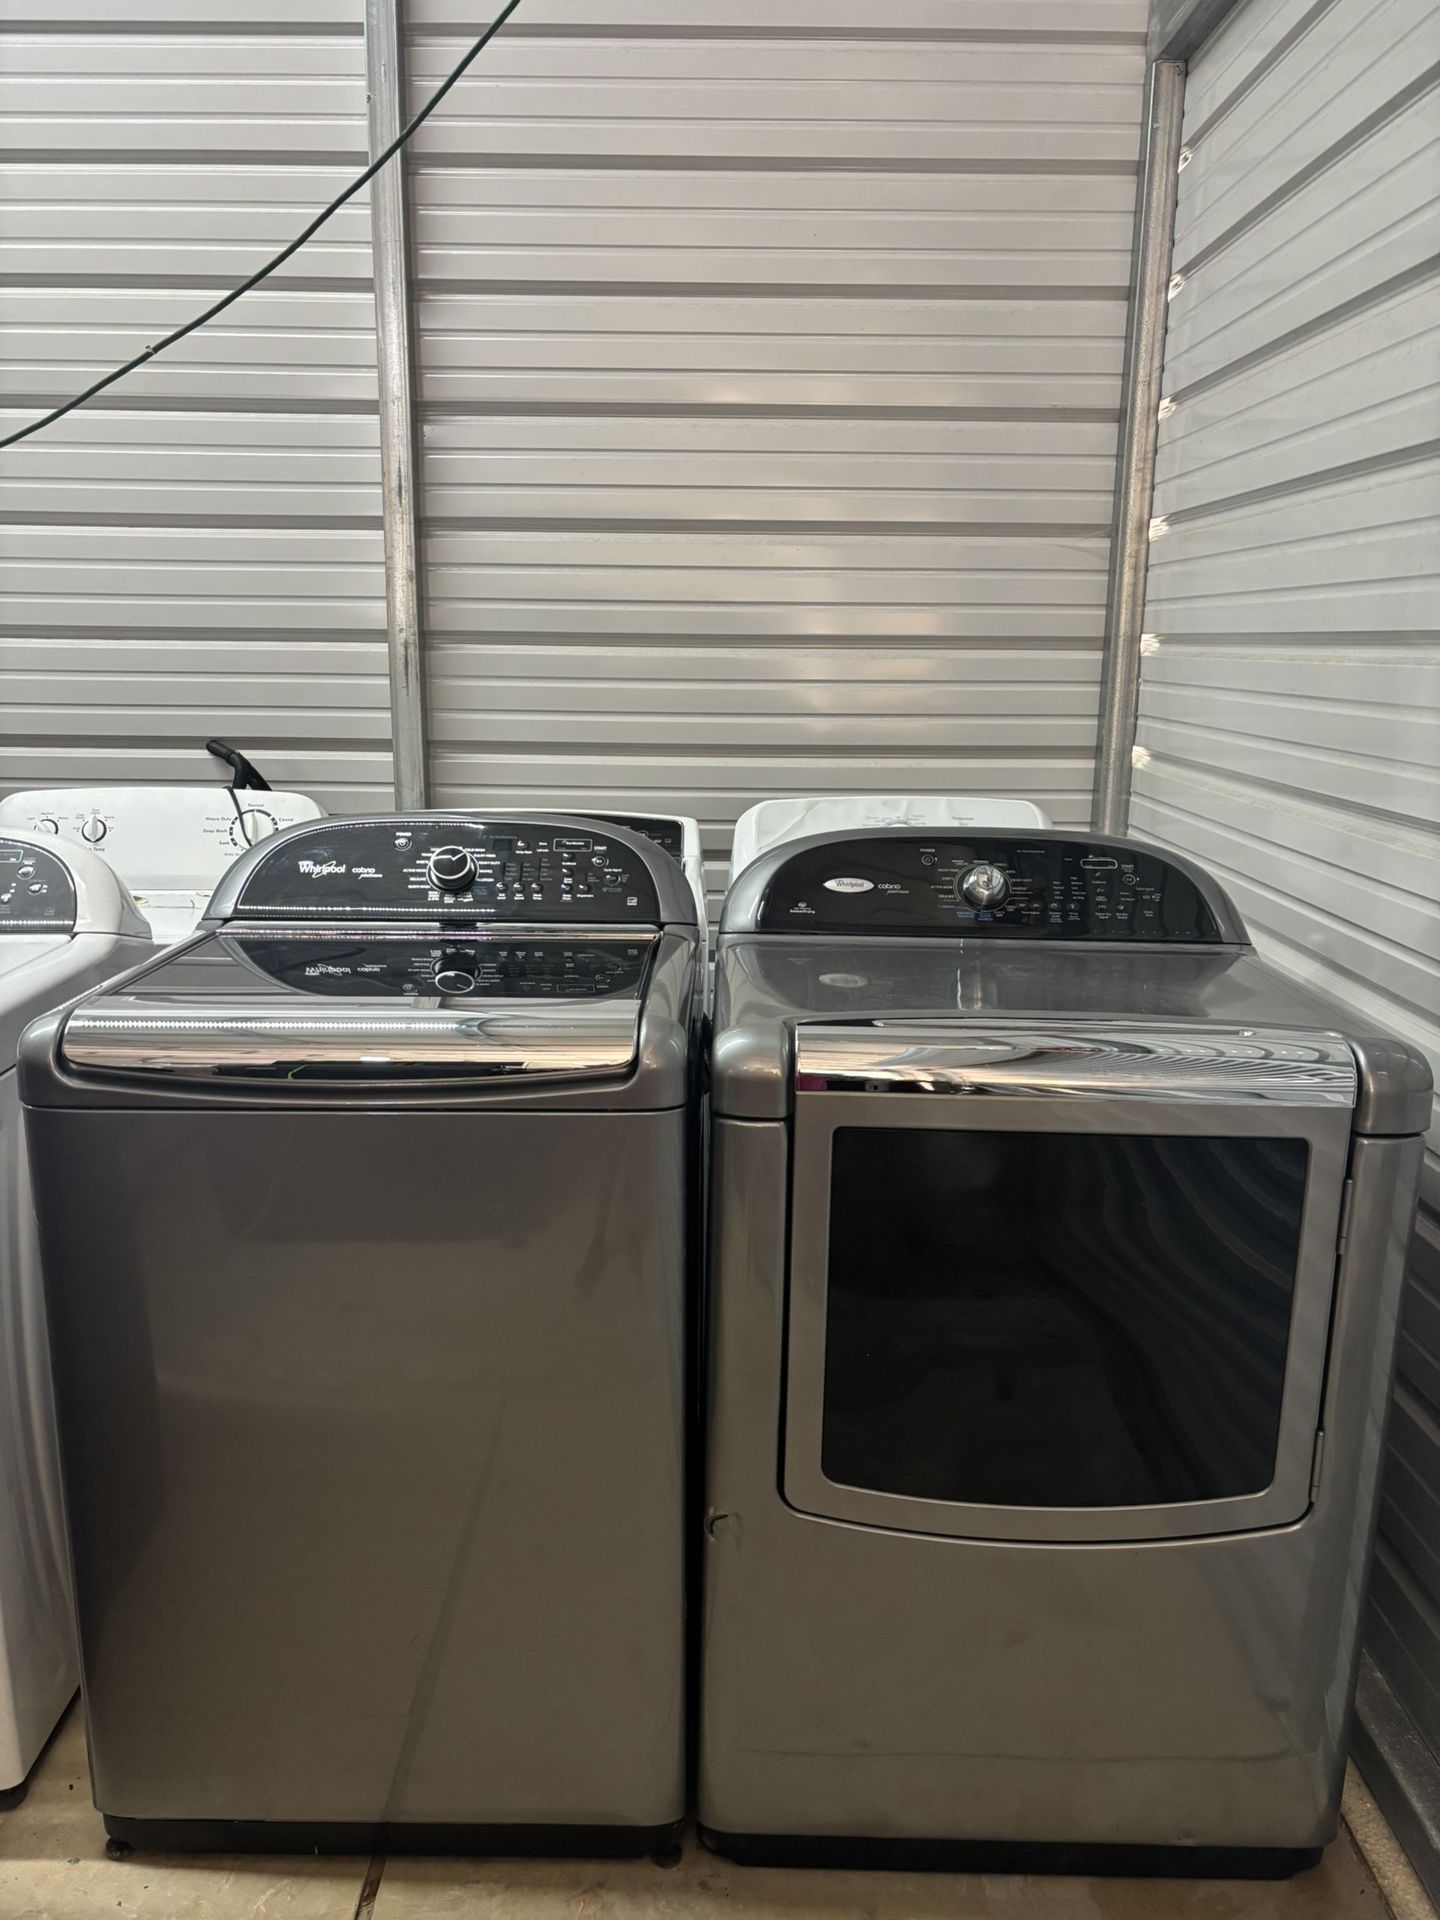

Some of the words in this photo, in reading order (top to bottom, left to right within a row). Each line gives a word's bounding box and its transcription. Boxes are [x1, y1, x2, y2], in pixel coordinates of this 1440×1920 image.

[298, 860, 346, 878] Whirlpool
[352, 866, 376, 874] cabrio
[835, 879, 865, 889] Whirlpool
